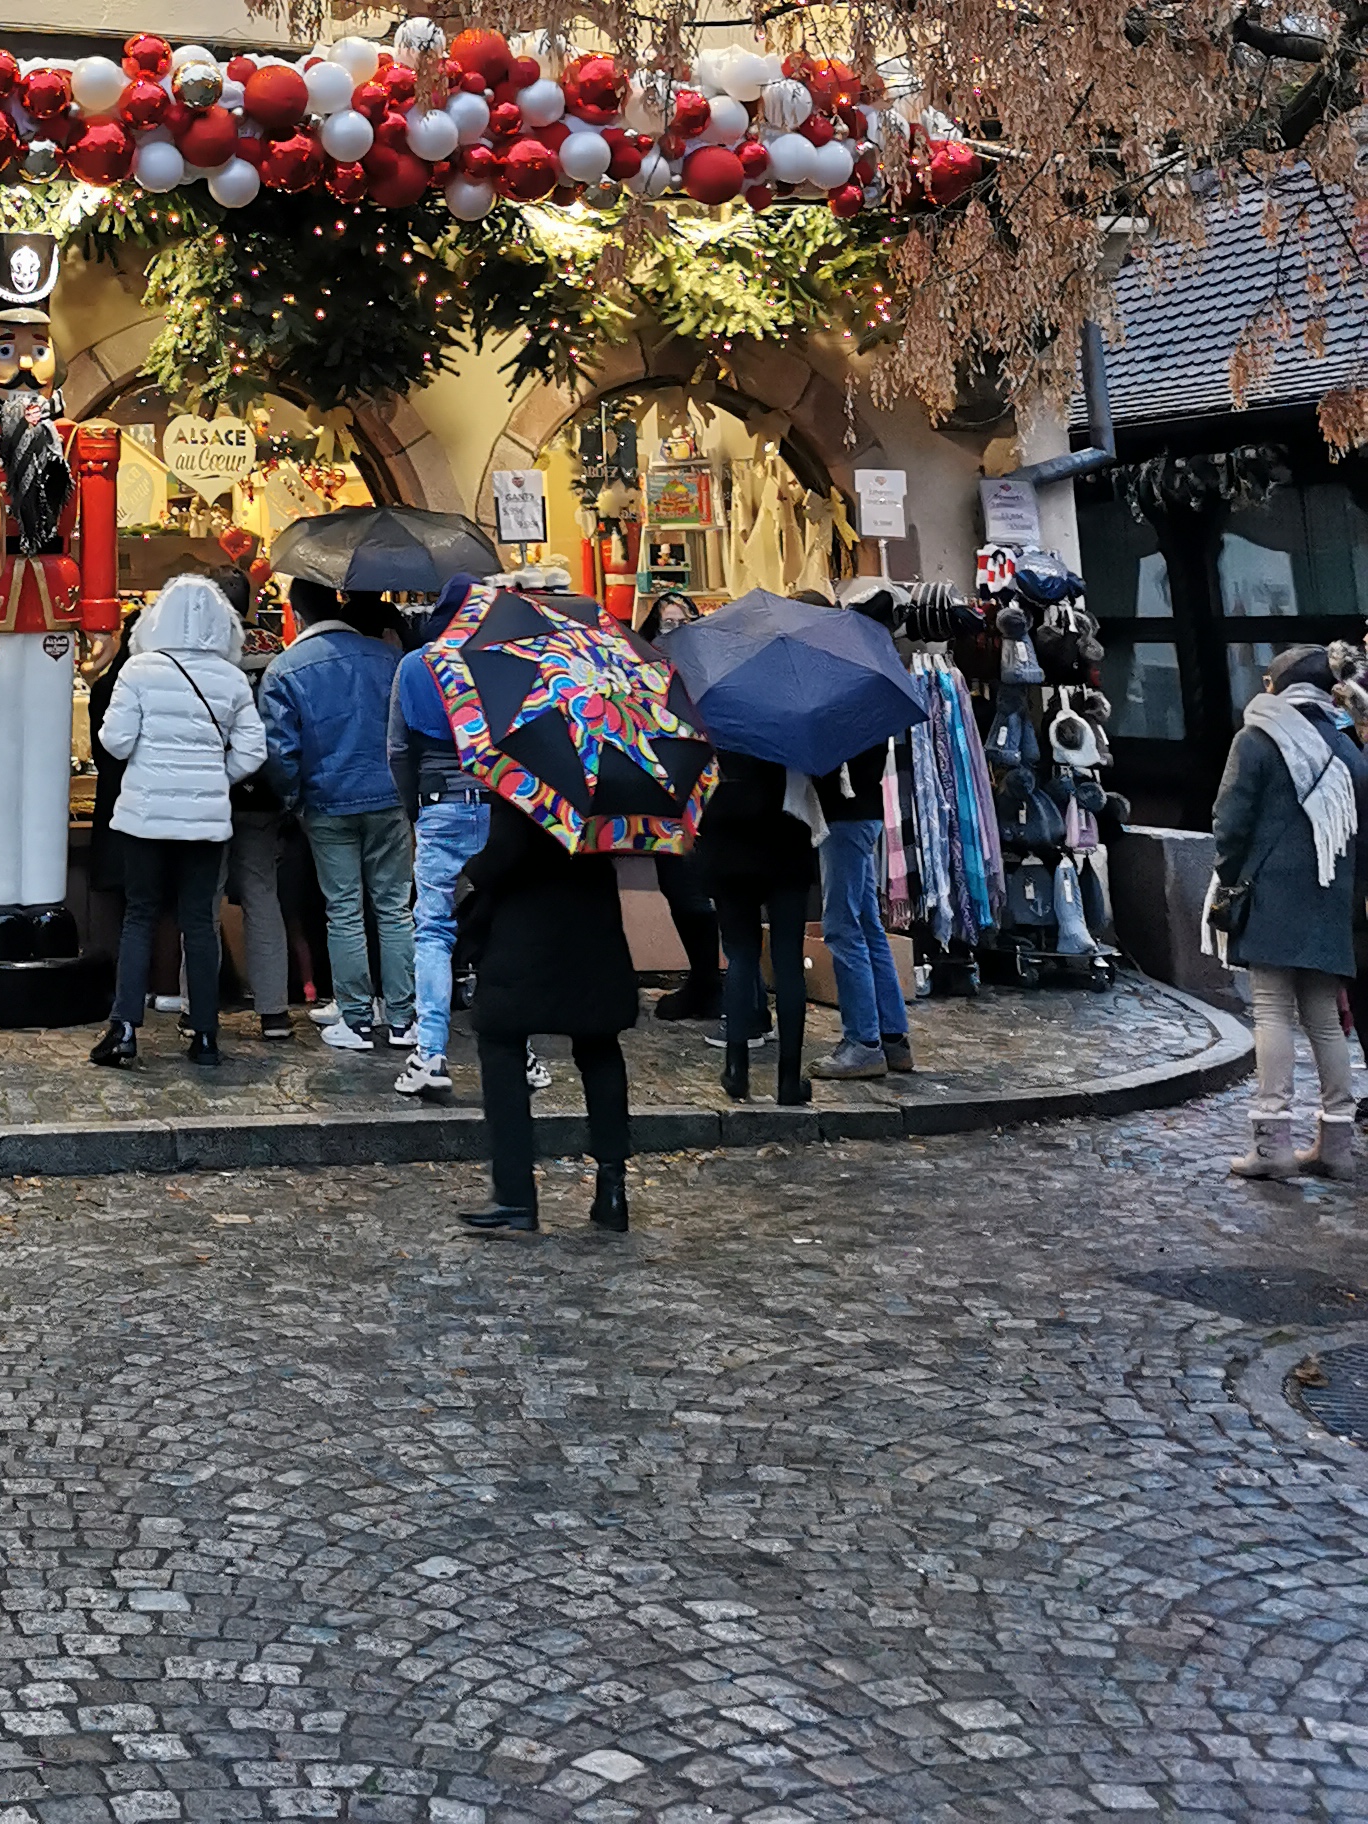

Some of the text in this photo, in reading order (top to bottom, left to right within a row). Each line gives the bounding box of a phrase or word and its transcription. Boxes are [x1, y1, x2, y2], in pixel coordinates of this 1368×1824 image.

[172, 427, 247, 447] ALSACE
[175, 447, 247, 473] au Cœur
